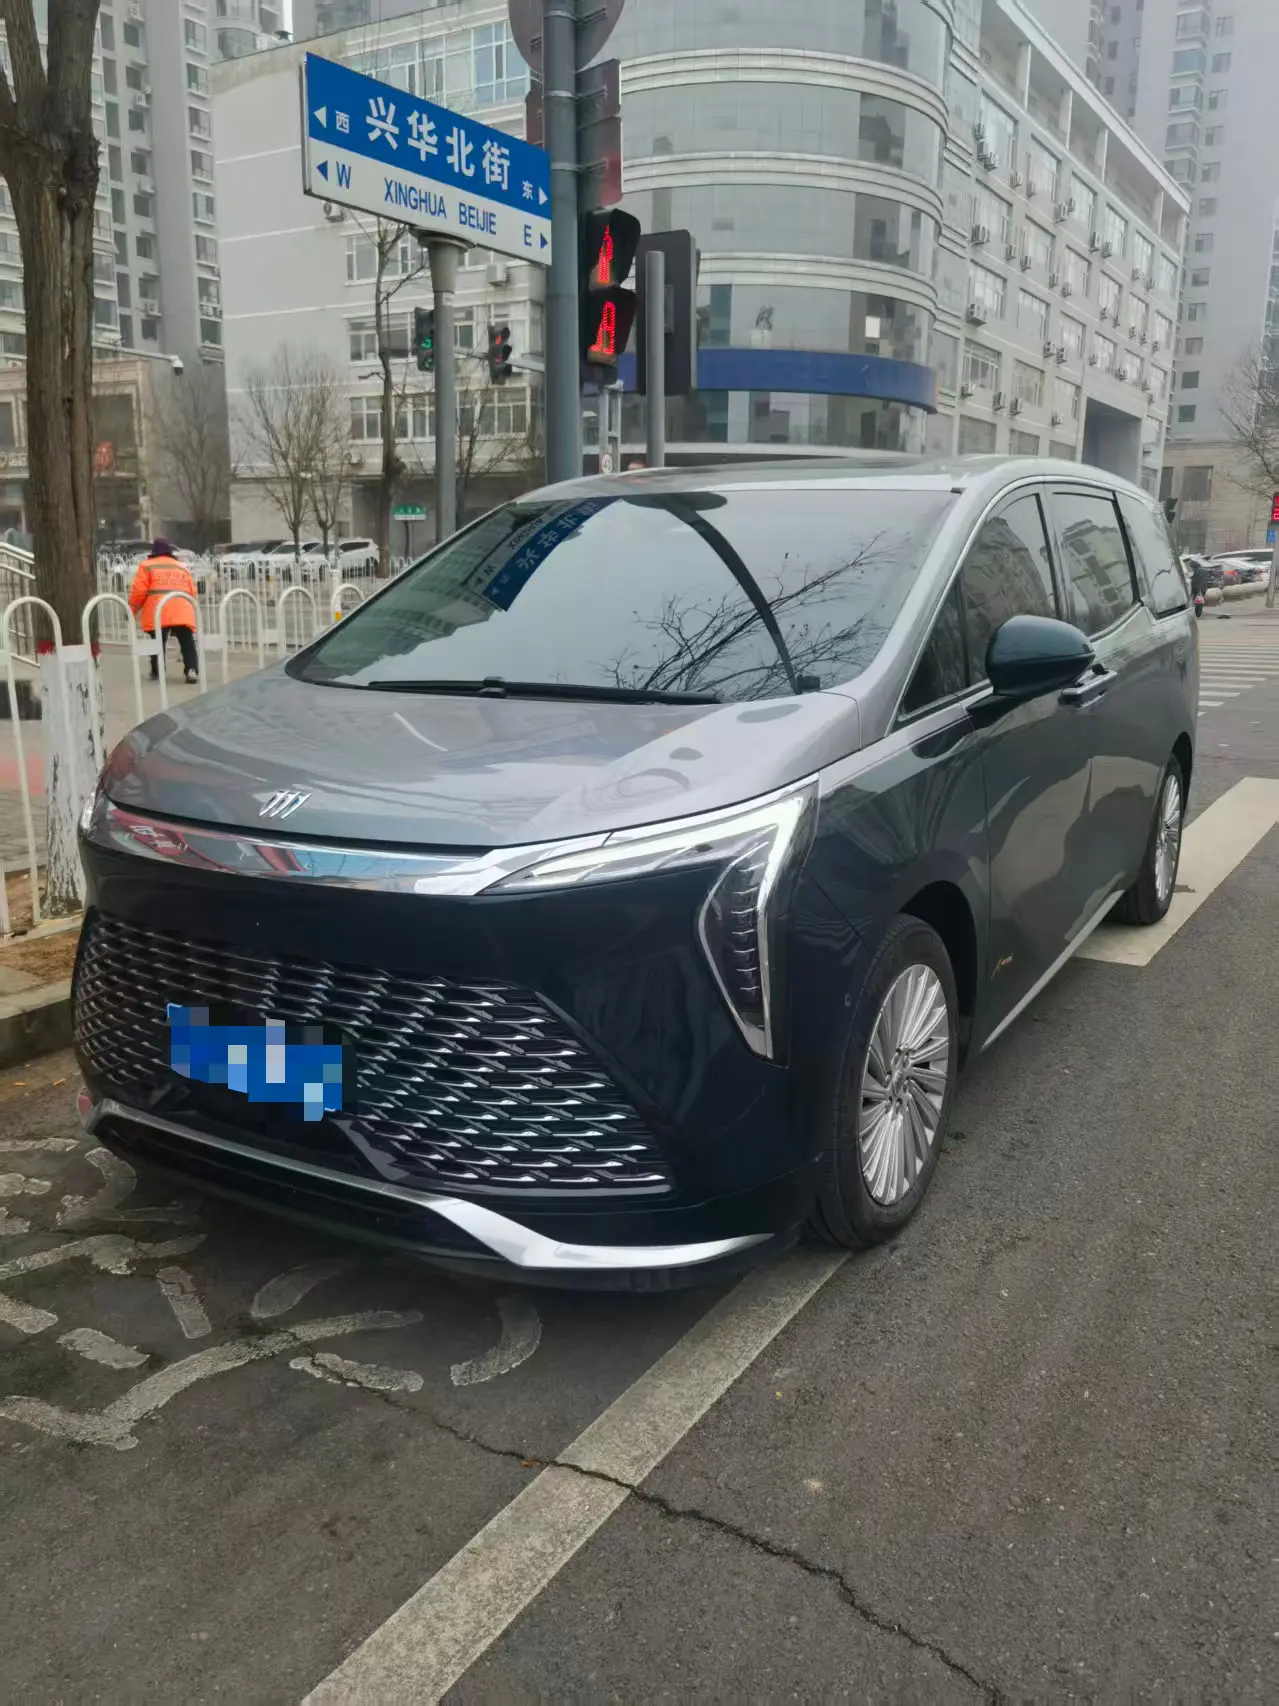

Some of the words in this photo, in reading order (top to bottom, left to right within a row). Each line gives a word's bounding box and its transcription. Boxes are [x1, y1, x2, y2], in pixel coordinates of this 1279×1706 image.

[335, 110, 350, 134] 西
[366, 97, 510, 191] 兴华北街
[522, 180, 533, 200] 东
[336, 161, 351, 189] W
[384, 178, 447, 220] XINGHUA
[458, 202, 497, 235] BEIJIE
[523, 224, 532, 246] E
